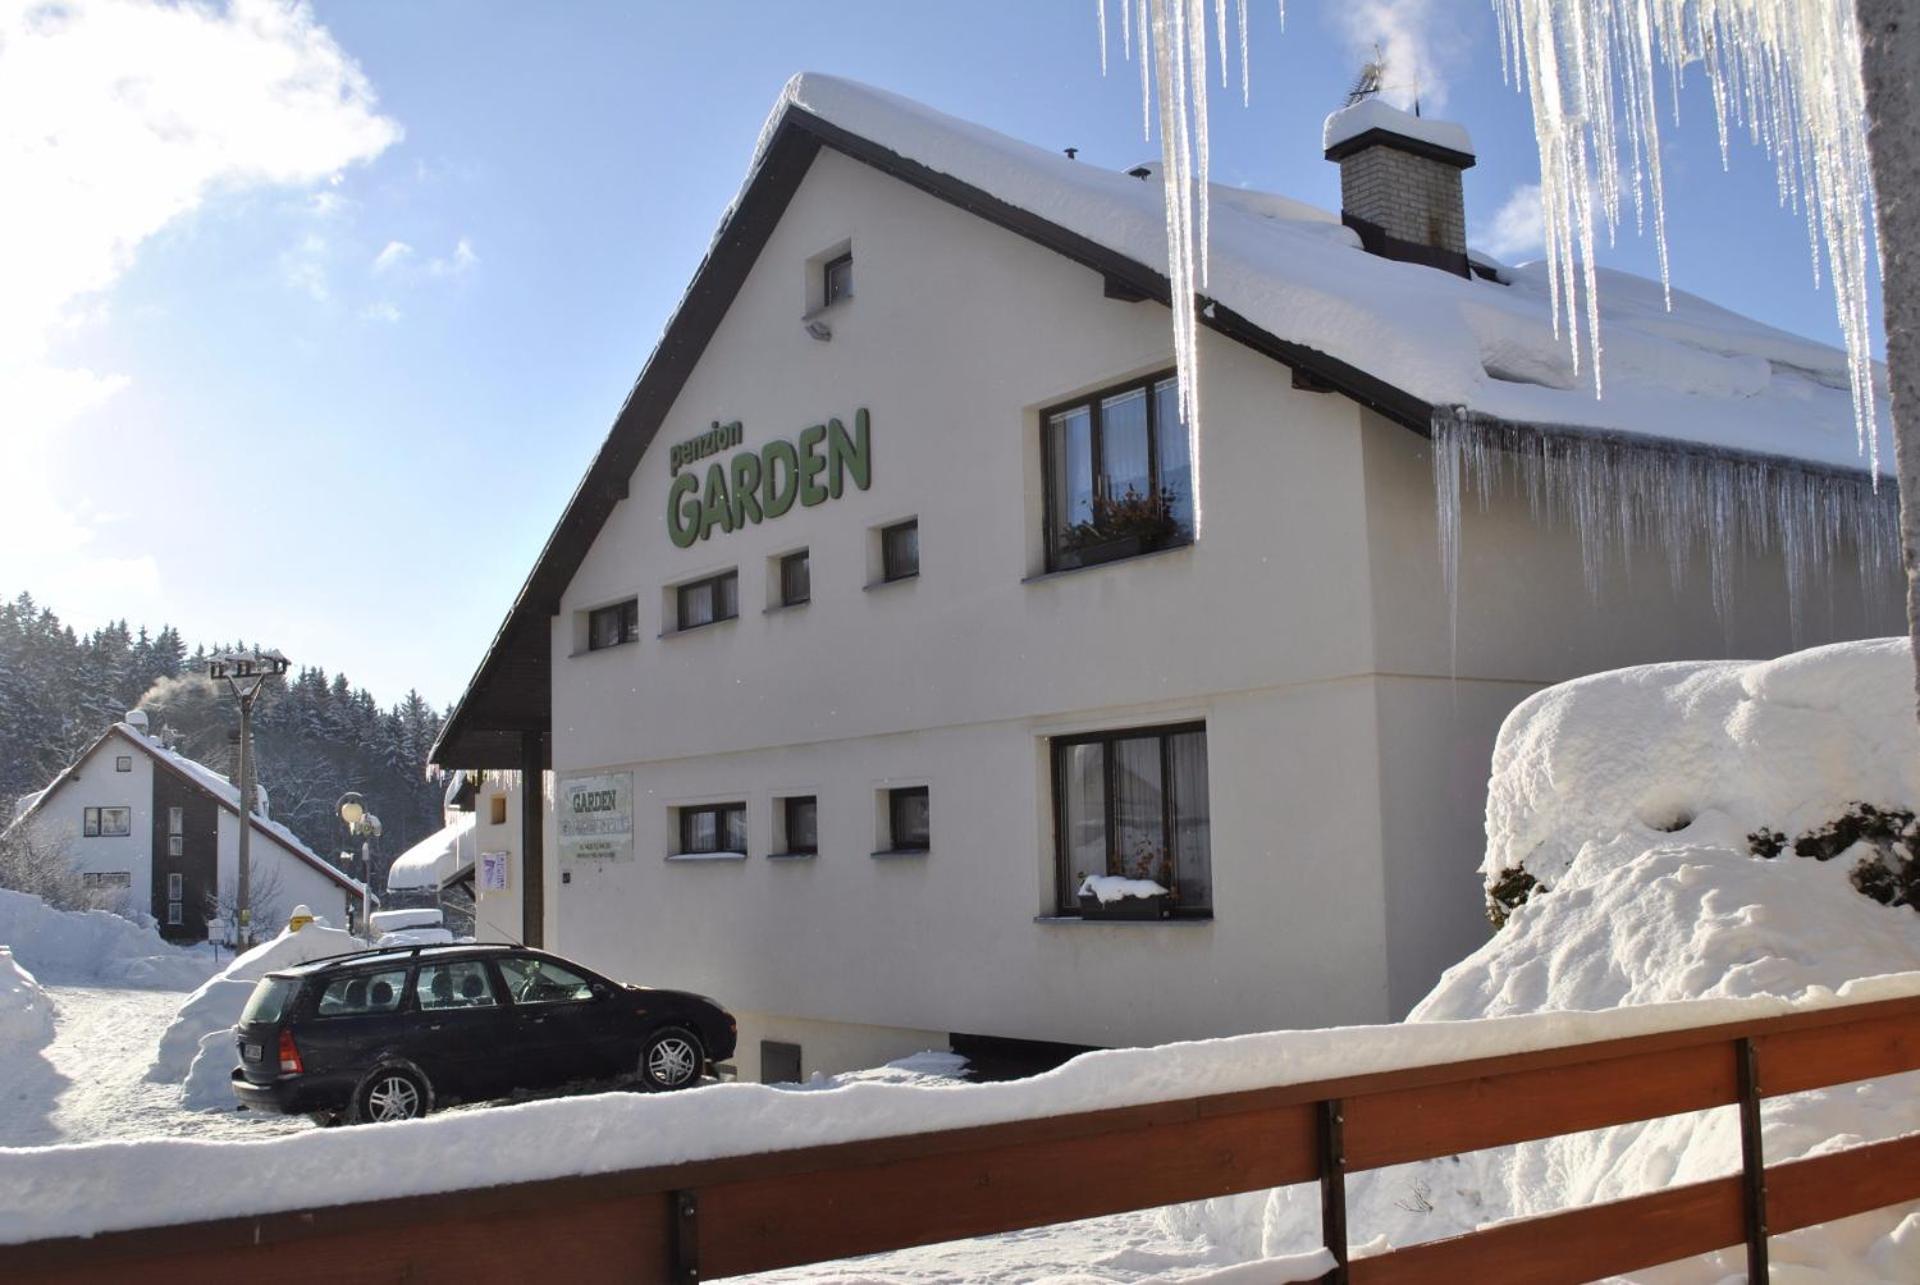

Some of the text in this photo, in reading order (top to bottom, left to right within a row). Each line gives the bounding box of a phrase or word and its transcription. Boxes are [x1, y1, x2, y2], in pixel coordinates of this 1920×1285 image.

[669, 420, 743, 477] penzion
[667, 408, 872, 549] GARDEN
[573, 789, 617, 813] GARDEN
